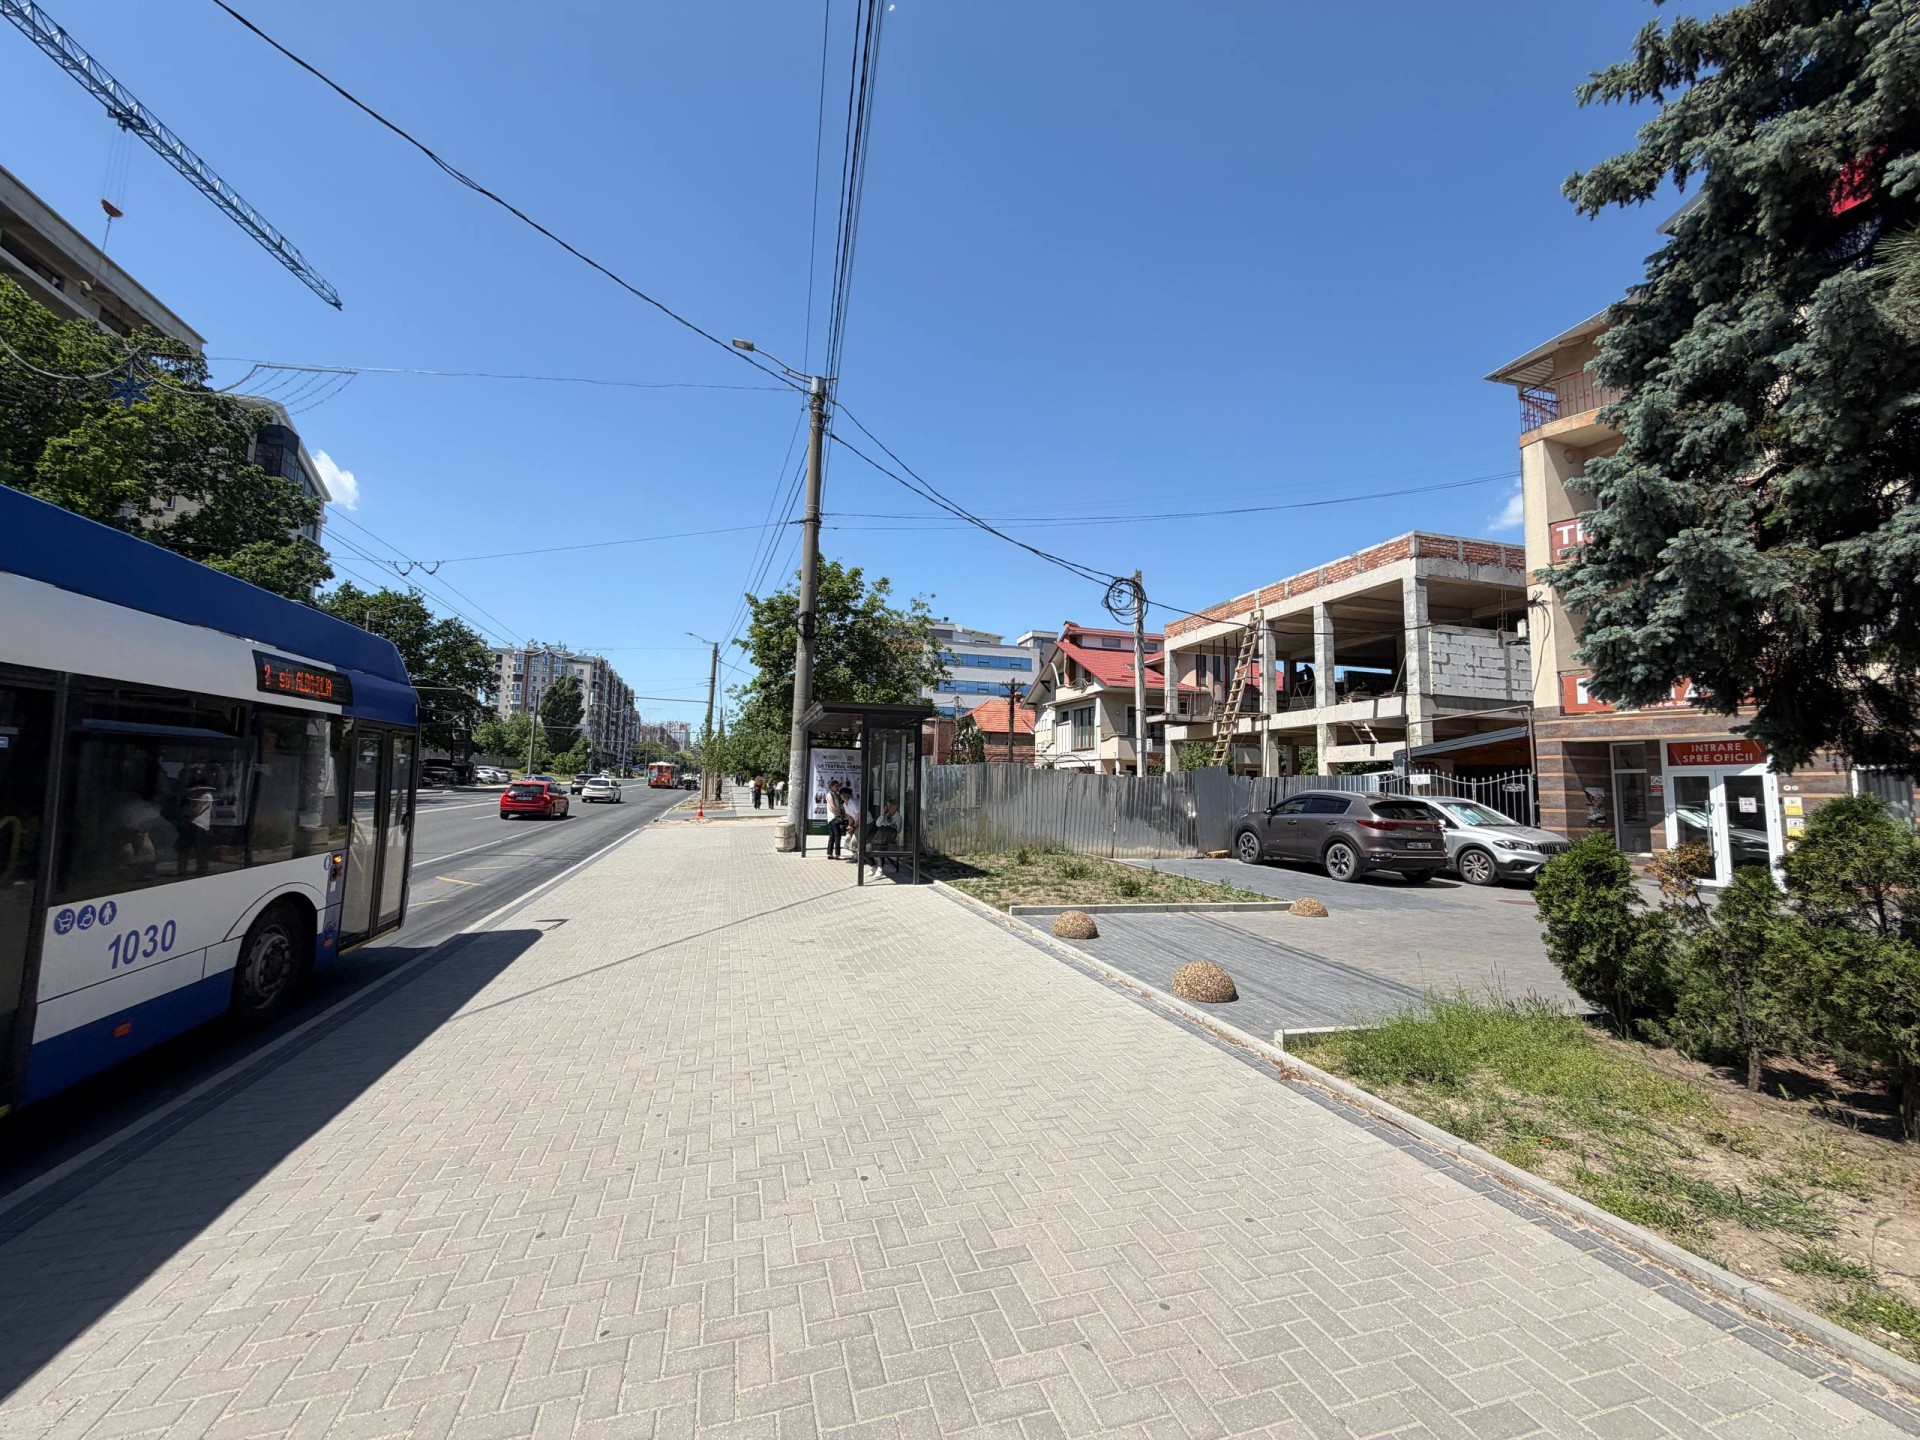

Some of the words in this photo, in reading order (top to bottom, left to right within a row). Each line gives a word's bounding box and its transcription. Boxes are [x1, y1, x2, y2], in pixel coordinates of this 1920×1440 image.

[1691, 742, 1742, 752] INTRARE
[1682, 754, 1710, 763] SPRE
[1713, 752, 1753, 762] OFICII
[107, 918, 177, 970] 1030
